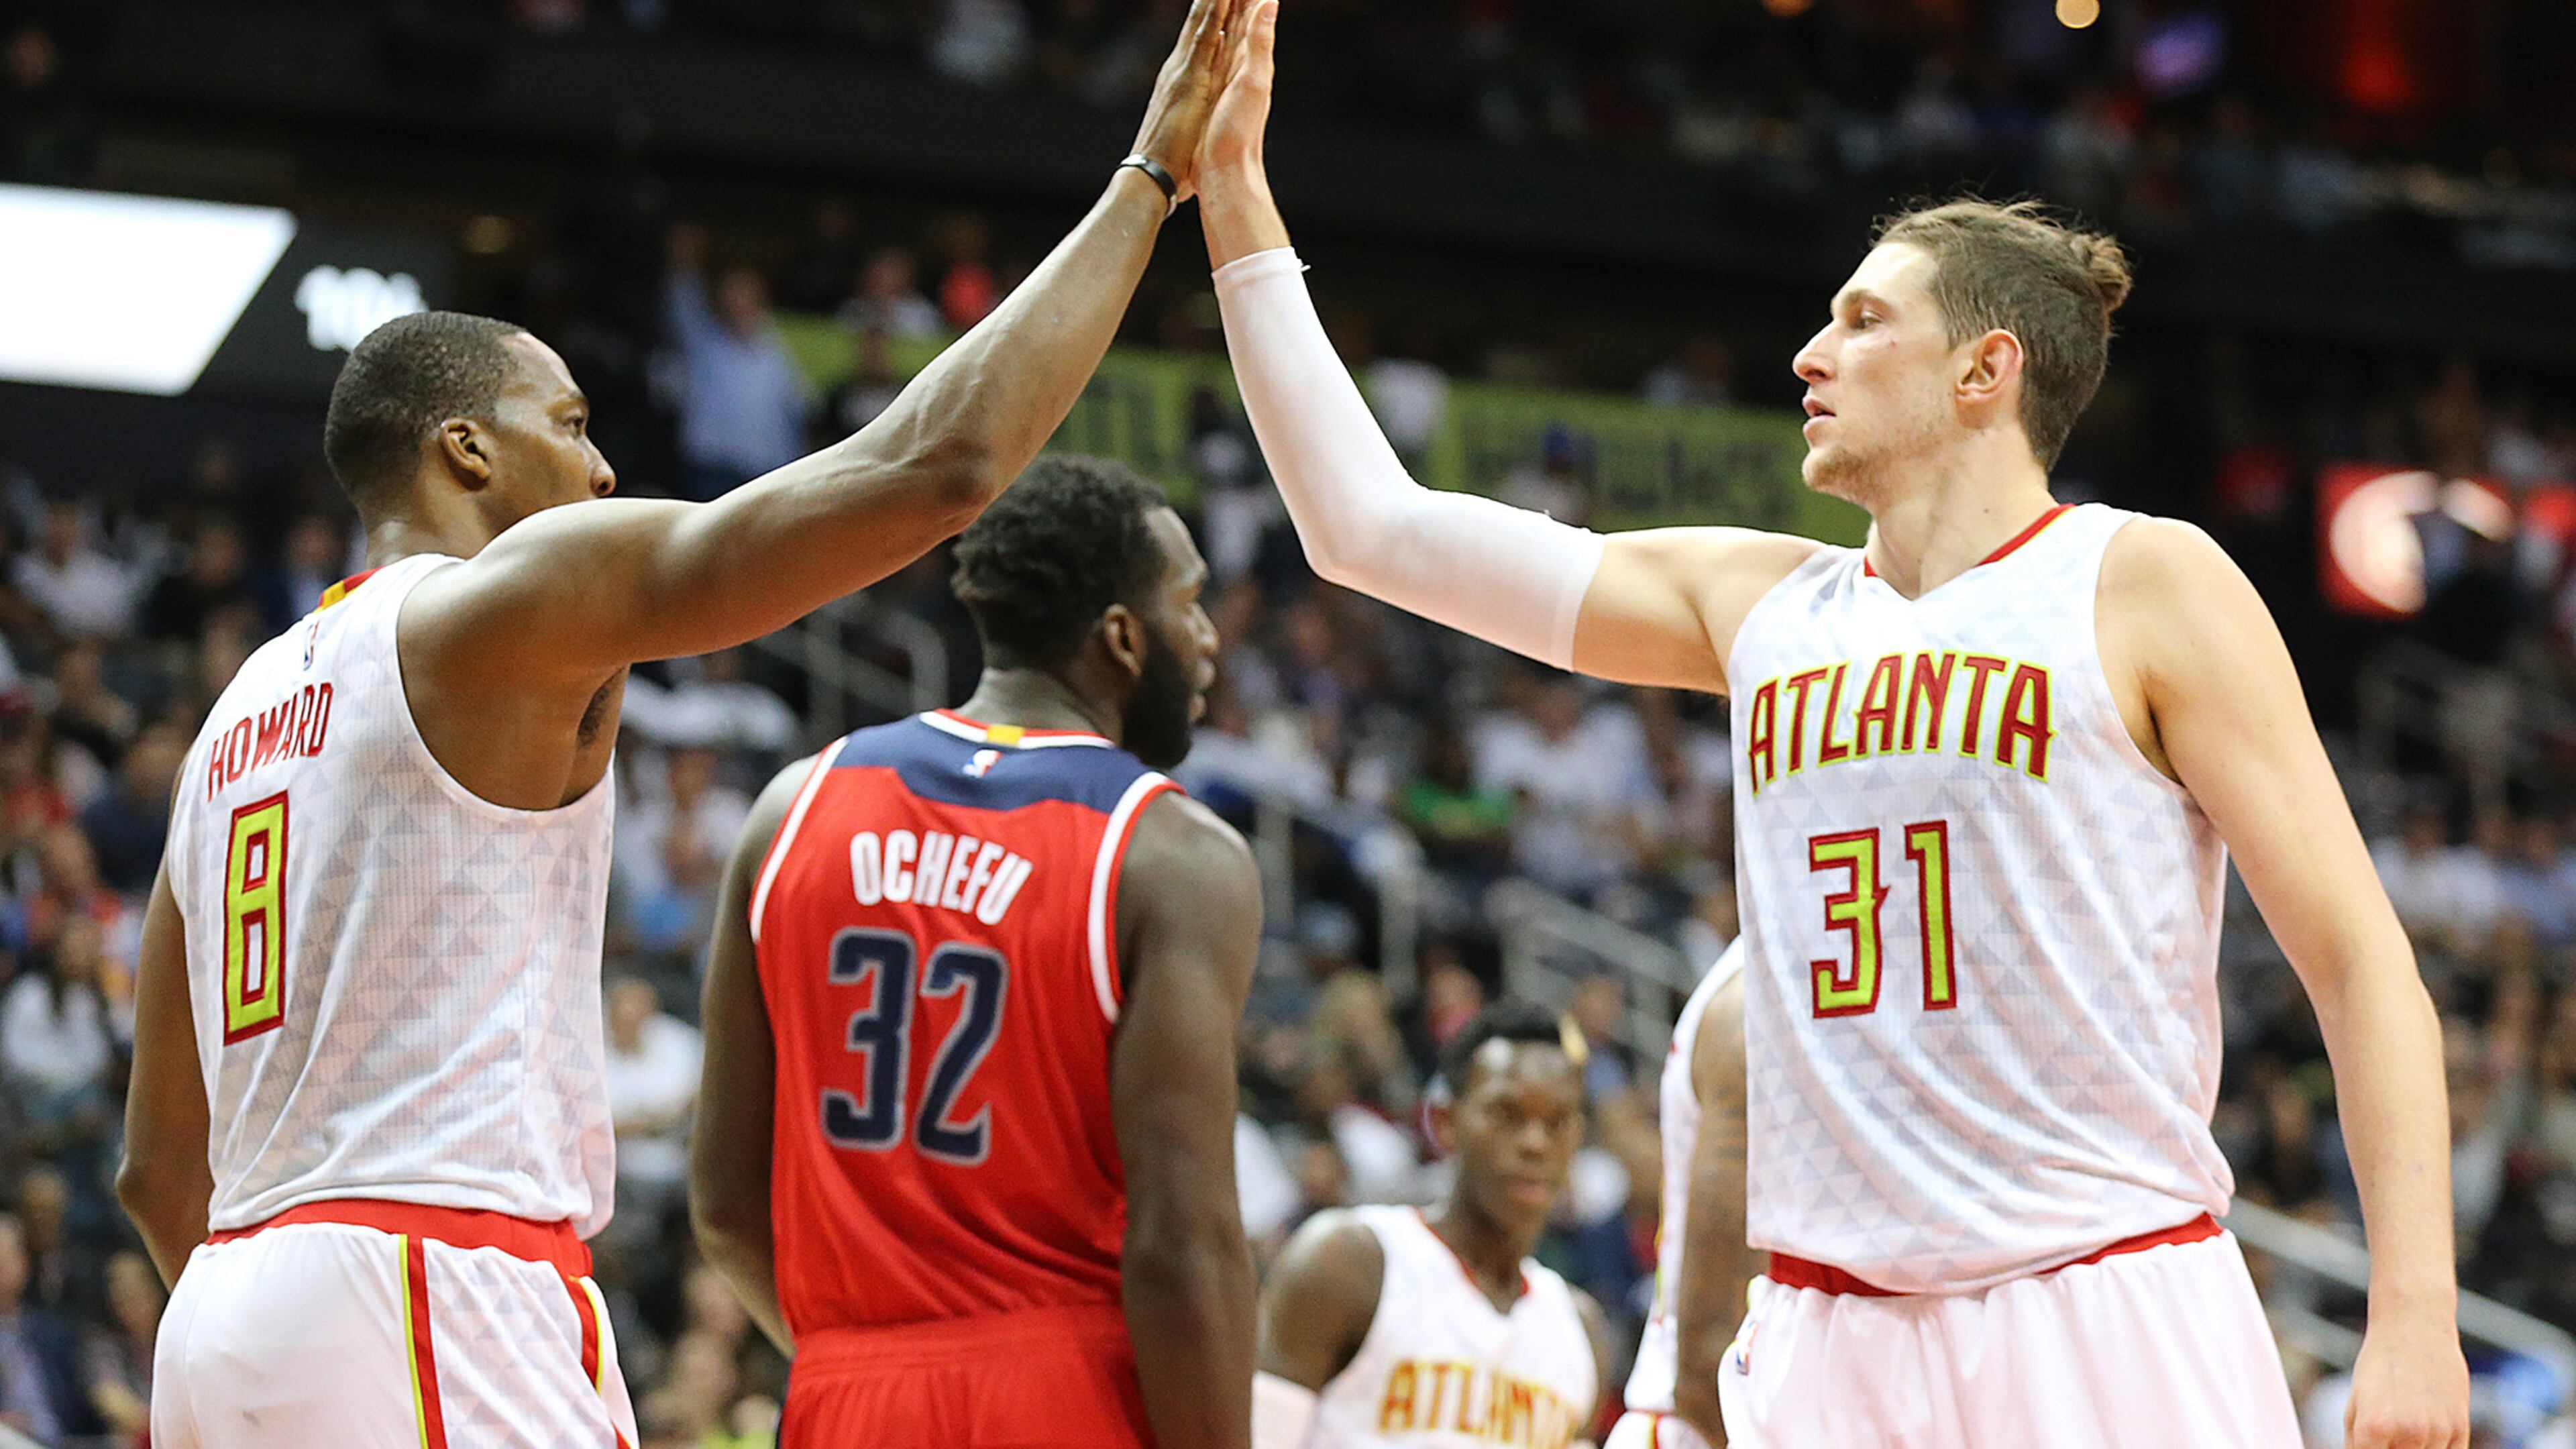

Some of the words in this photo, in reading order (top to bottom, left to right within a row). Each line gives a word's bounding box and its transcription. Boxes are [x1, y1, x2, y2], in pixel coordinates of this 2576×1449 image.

[208, 682, 333, 802] HOWARD
[1748, 649, 2058, 800] ATLANTA
[224, 790, 290, 1046] 8
[849, 829, 1032, 925] OCHEFU
[1808, 819, 1957, 1019] 31
[820, 926, 1010, 1166] 32
